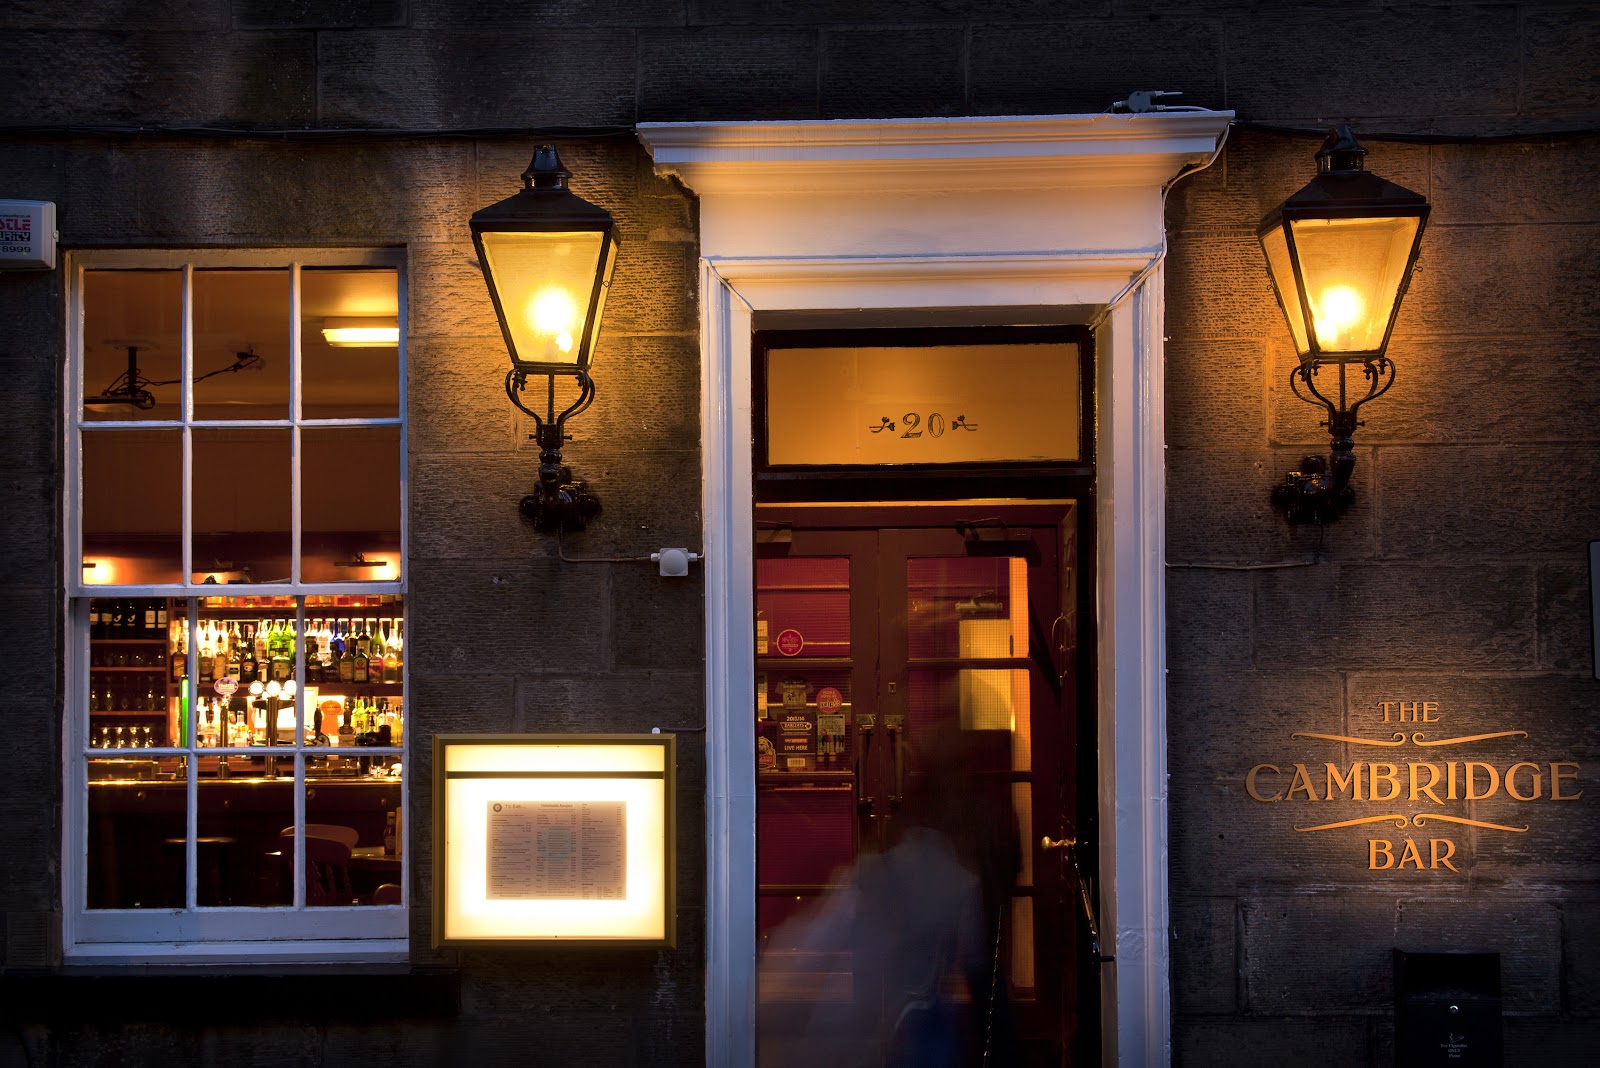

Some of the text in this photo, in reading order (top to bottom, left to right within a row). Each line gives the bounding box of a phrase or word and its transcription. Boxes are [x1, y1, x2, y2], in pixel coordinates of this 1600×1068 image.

[900, 412, 945, 439] 20
[1377, 701, 1441, 724] THE
[1245, 761, 1585, 806] CAMBRIDGE
[1368, 838, 1460, 874] BAR
